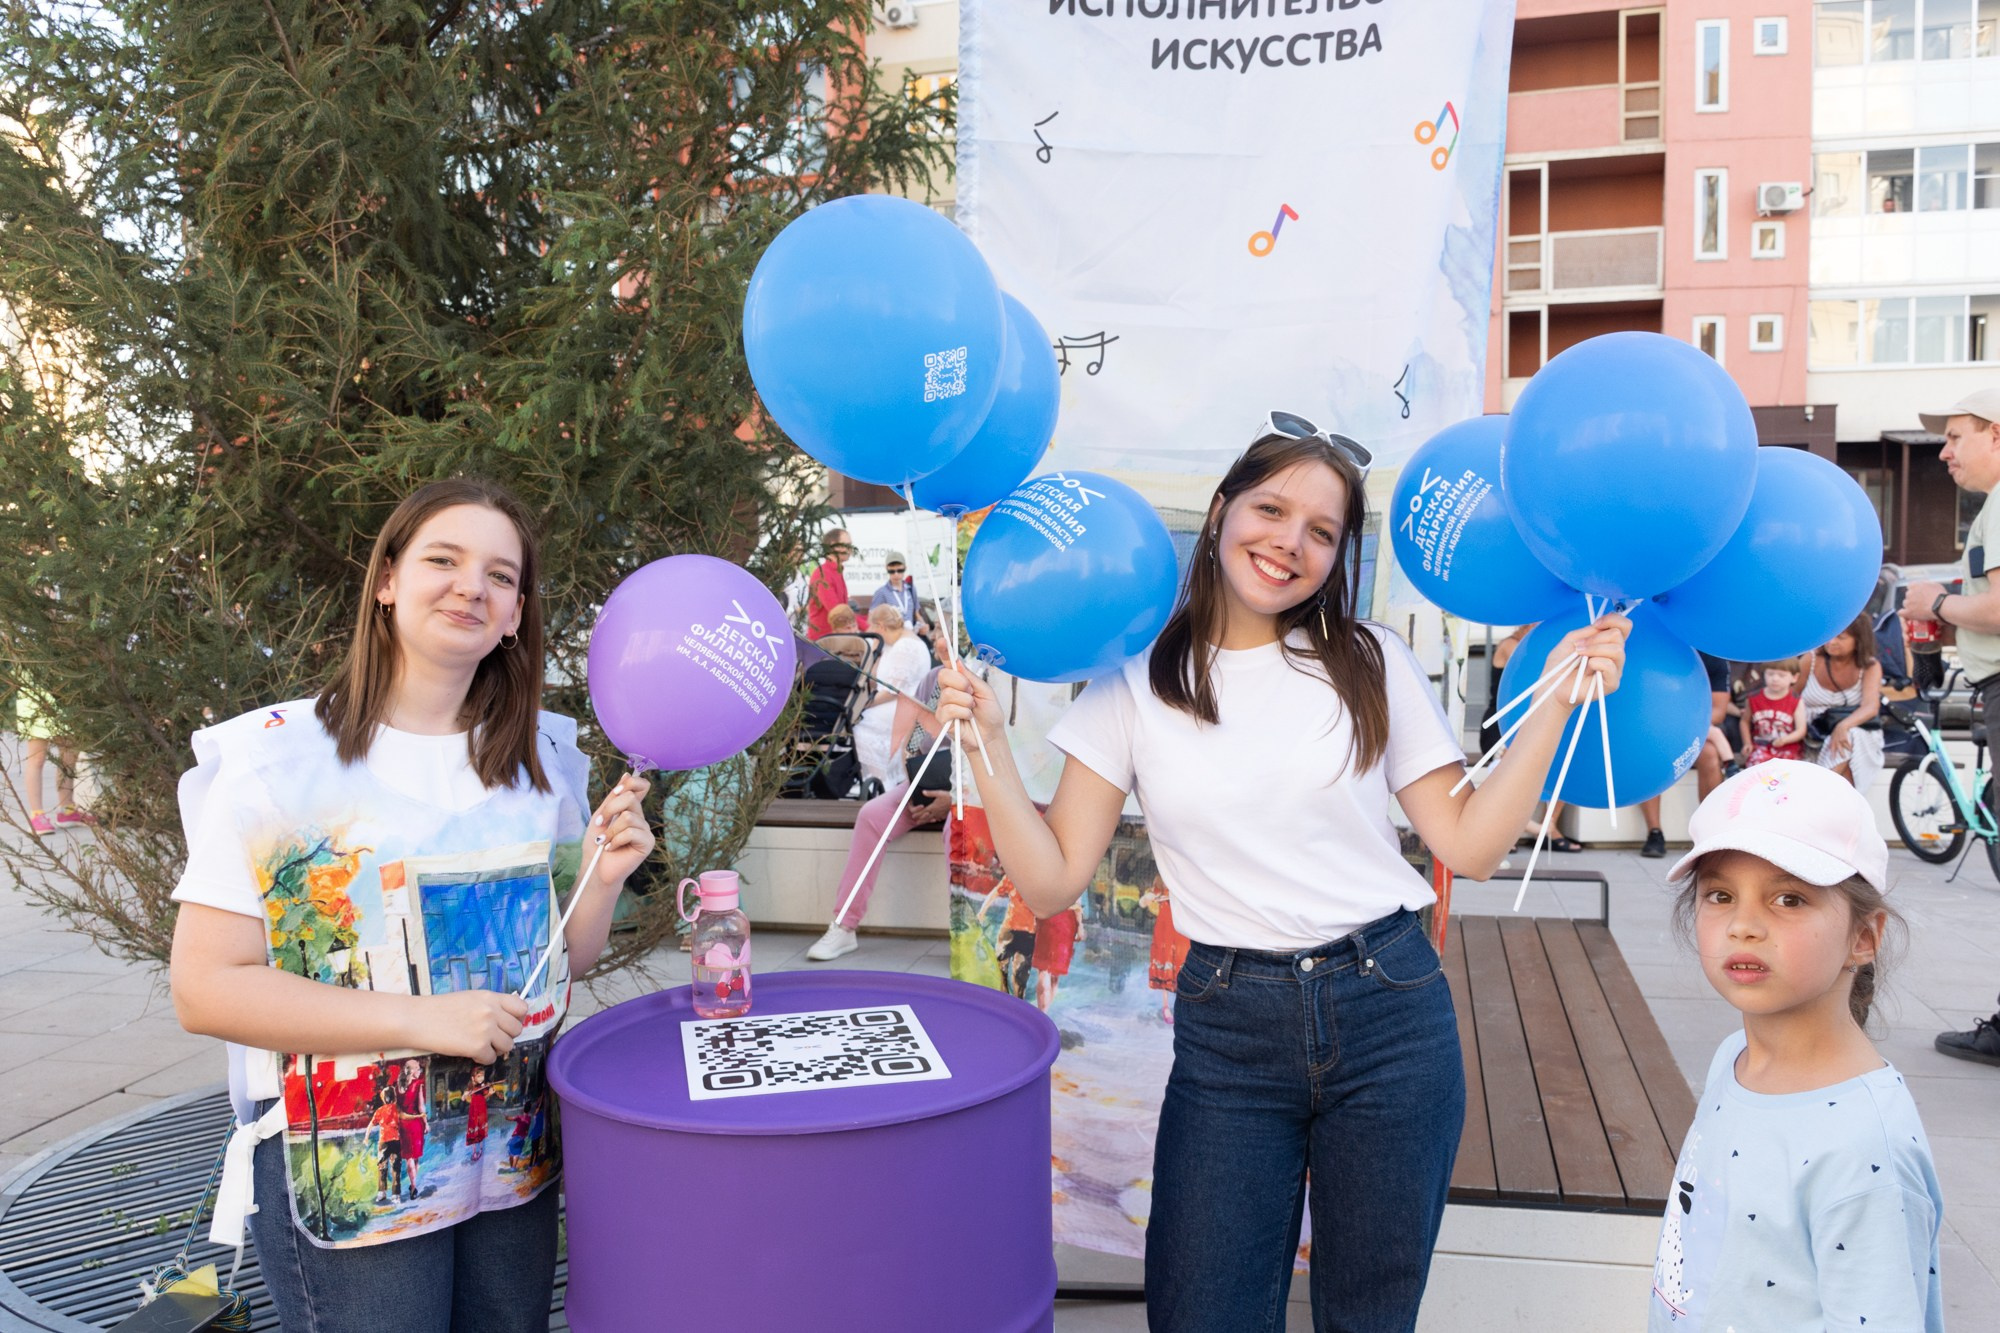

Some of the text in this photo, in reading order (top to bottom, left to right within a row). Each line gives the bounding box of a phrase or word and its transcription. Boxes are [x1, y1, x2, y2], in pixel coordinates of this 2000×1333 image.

[1049, 0, 1384, 20] ИСПОЛНИТЕ
[1151, 22, 1383, 74] ИСКУССТВА
[1027, 482, 1083, 514] ДЕТСКАЯ
[1414, 479, 1452, 550] ДЕТСКАЯ
[1422, 469, 1477, 572] ФИЛАРМОНИЯ
[1448, 483, 1494, 551] АБДУРАХМАНОВА
[1011, 508, 1067, 553] АБДУРАХМАНОВА
[1040, 513, 1075, 545] ОБЛАСТИ
[1434, 476, 1486, 577] ЧЕЛЯБИНСКОЙ ОБЛАСТИ
[683, 635, 769, 707] ЧЕЛЯБИНСКОЙ ОБЛАСТИ
[690, 623, 777, 697] ФИЛАРМОНИЯ
[715, 622, 775, 673] ДЕТСКАЯ
[709, 666, 762, 715] АБДУРАХМАНОВА
